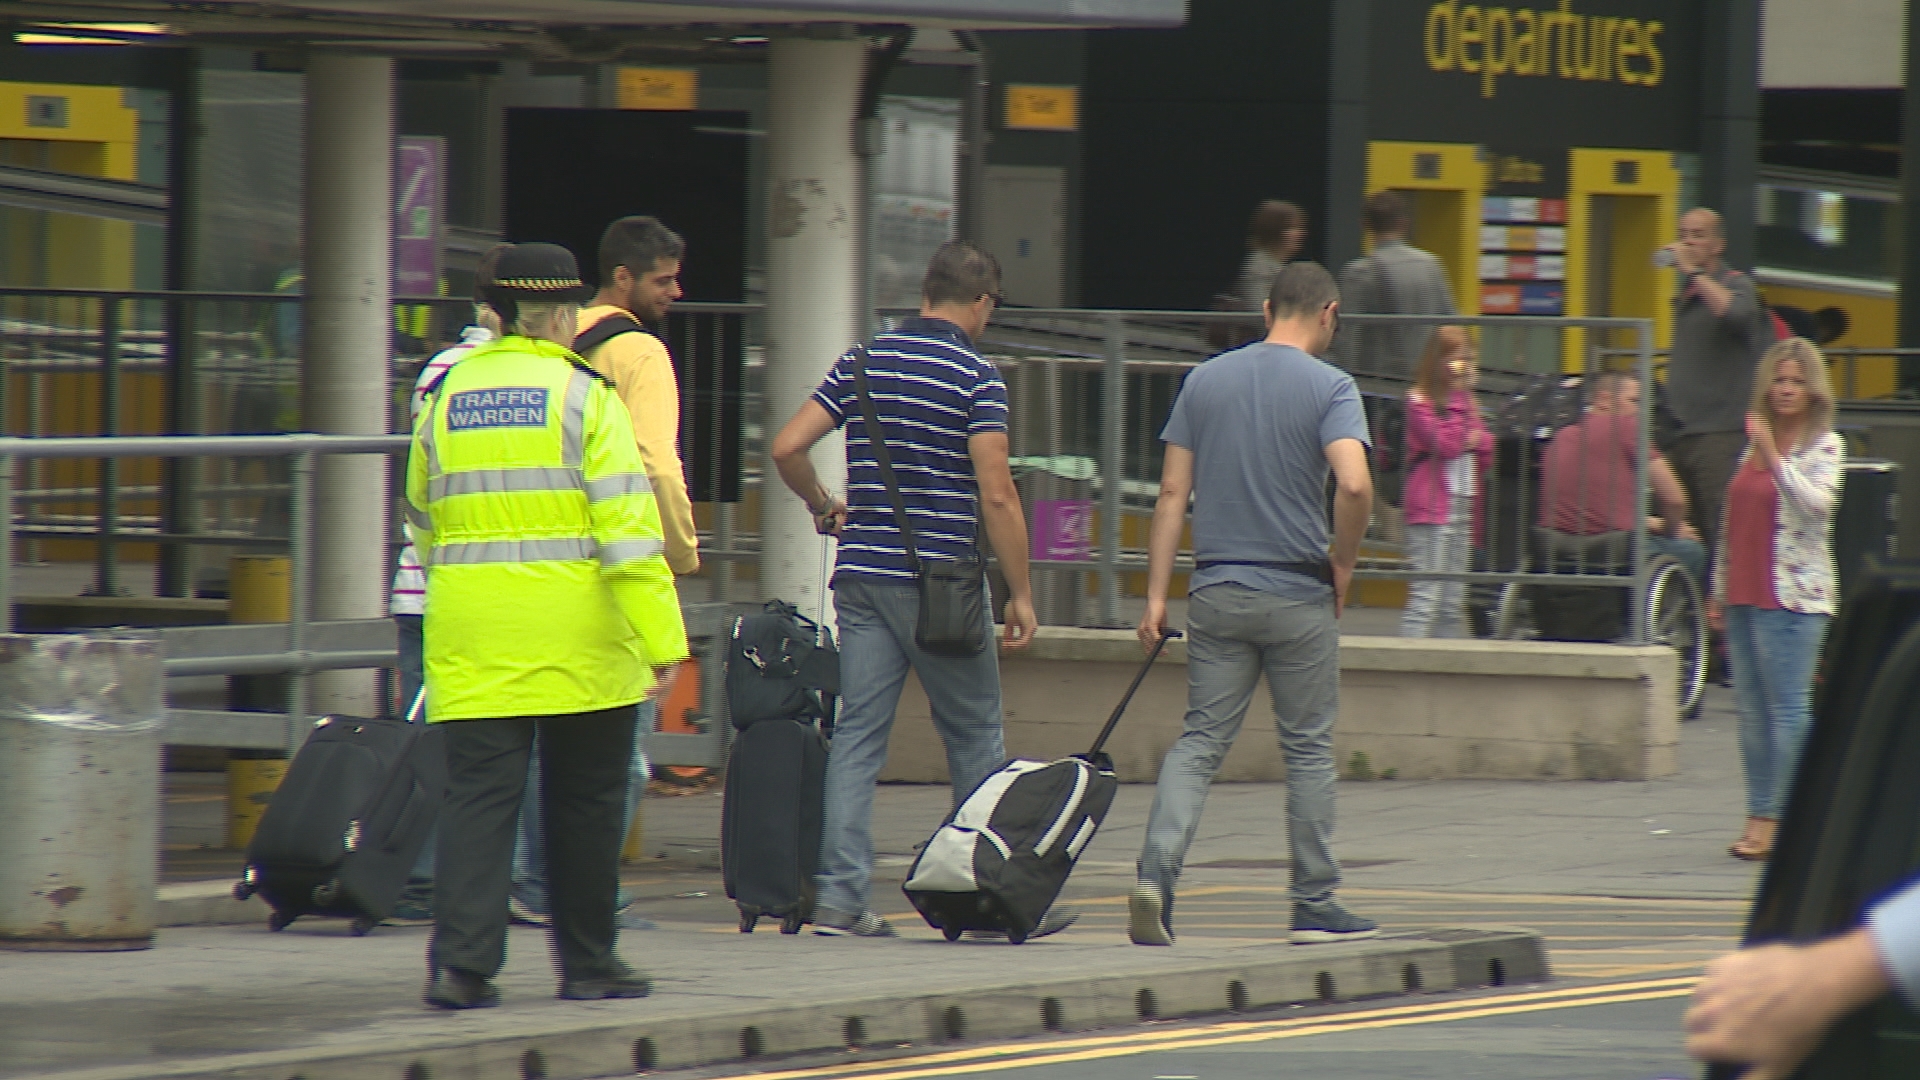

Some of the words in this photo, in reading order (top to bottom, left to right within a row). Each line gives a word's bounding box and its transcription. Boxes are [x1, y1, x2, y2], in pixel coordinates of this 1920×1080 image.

[1424, 0, 1665, 98] departures
[453, 391, 543, 409] TRAFFIC
[450, 407, 544, 427] WARDEN
